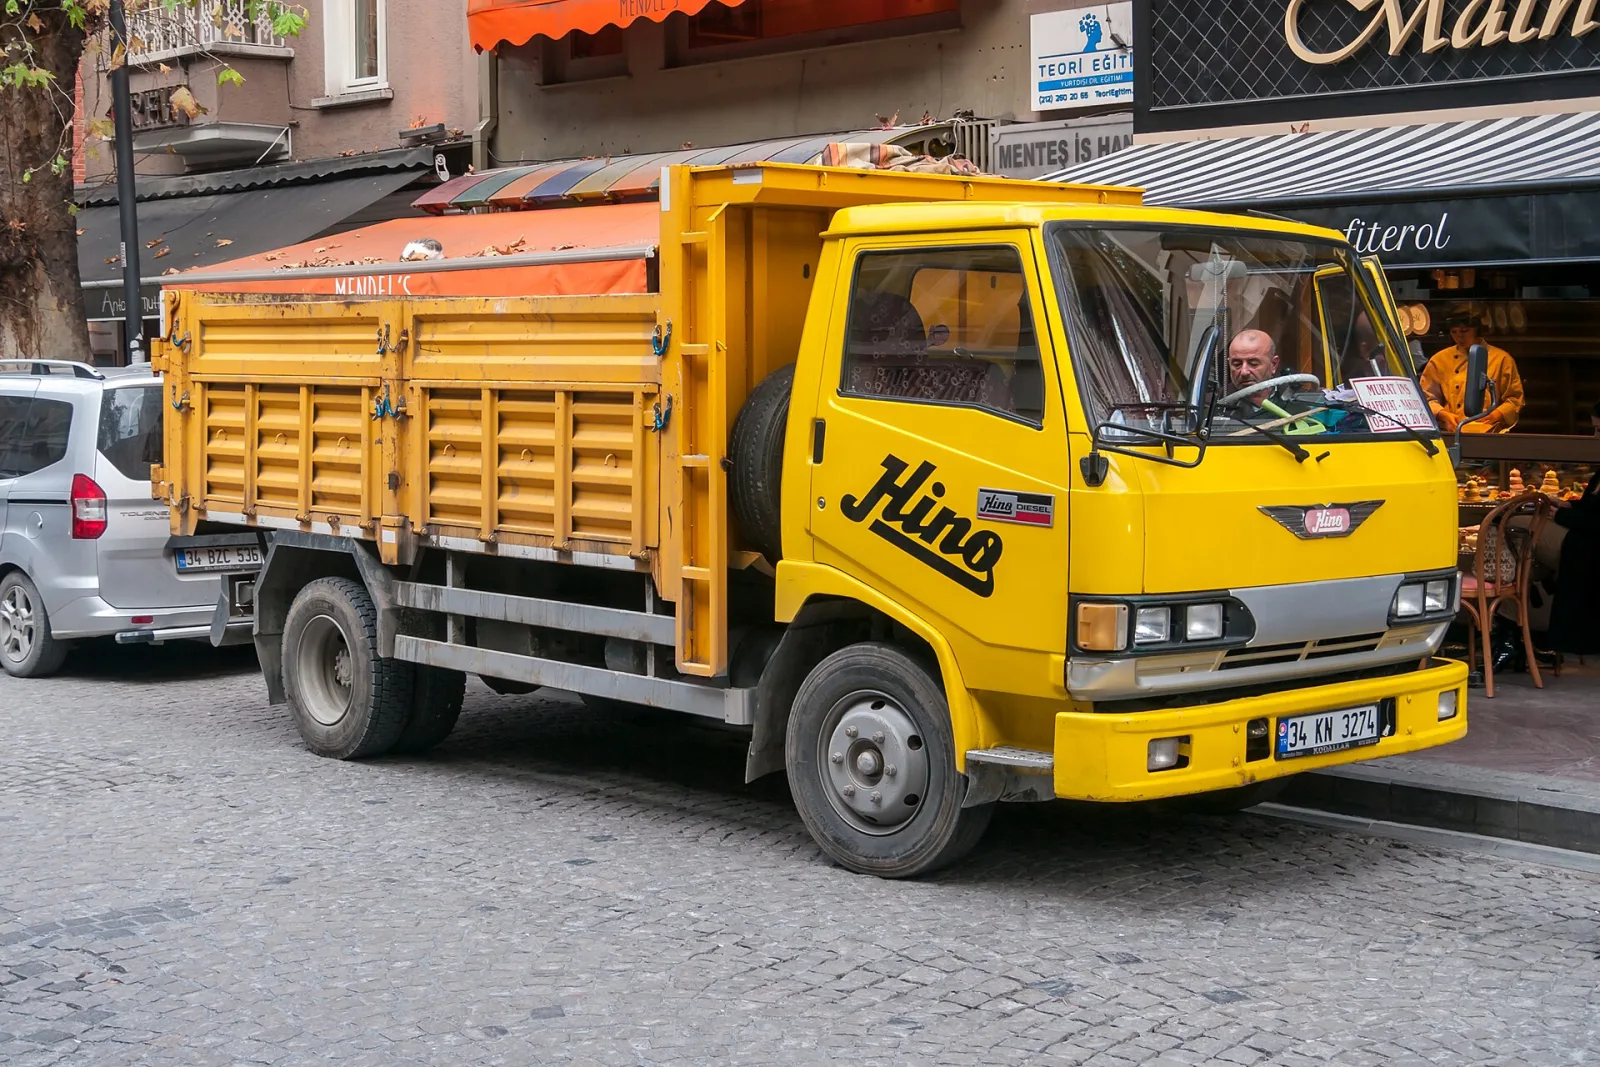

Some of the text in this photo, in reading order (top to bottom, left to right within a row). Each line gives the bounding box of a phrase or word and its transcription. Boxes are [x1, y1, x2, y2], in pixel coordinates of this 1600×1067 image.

[1069, 93, 1079, 101] 20
[999, 139, 1069, 169] MENTEŞ
[1366, 383, 1397, 396] MURAT
[980, 494, 1051, 515] Hino DIESEL
[840, 453, 1003, 598] Hino
[1312, 509, 1343, 533] Hino
[187, 549, 201, 566] 34
[208, 547, 231, 565] BZC
[237, 546, 259, 563] 536
[1289, 720, 1307, 748] 34
[1315, 716, 1333, 744] KN
[1341, 709, 1375, 739] 3274
